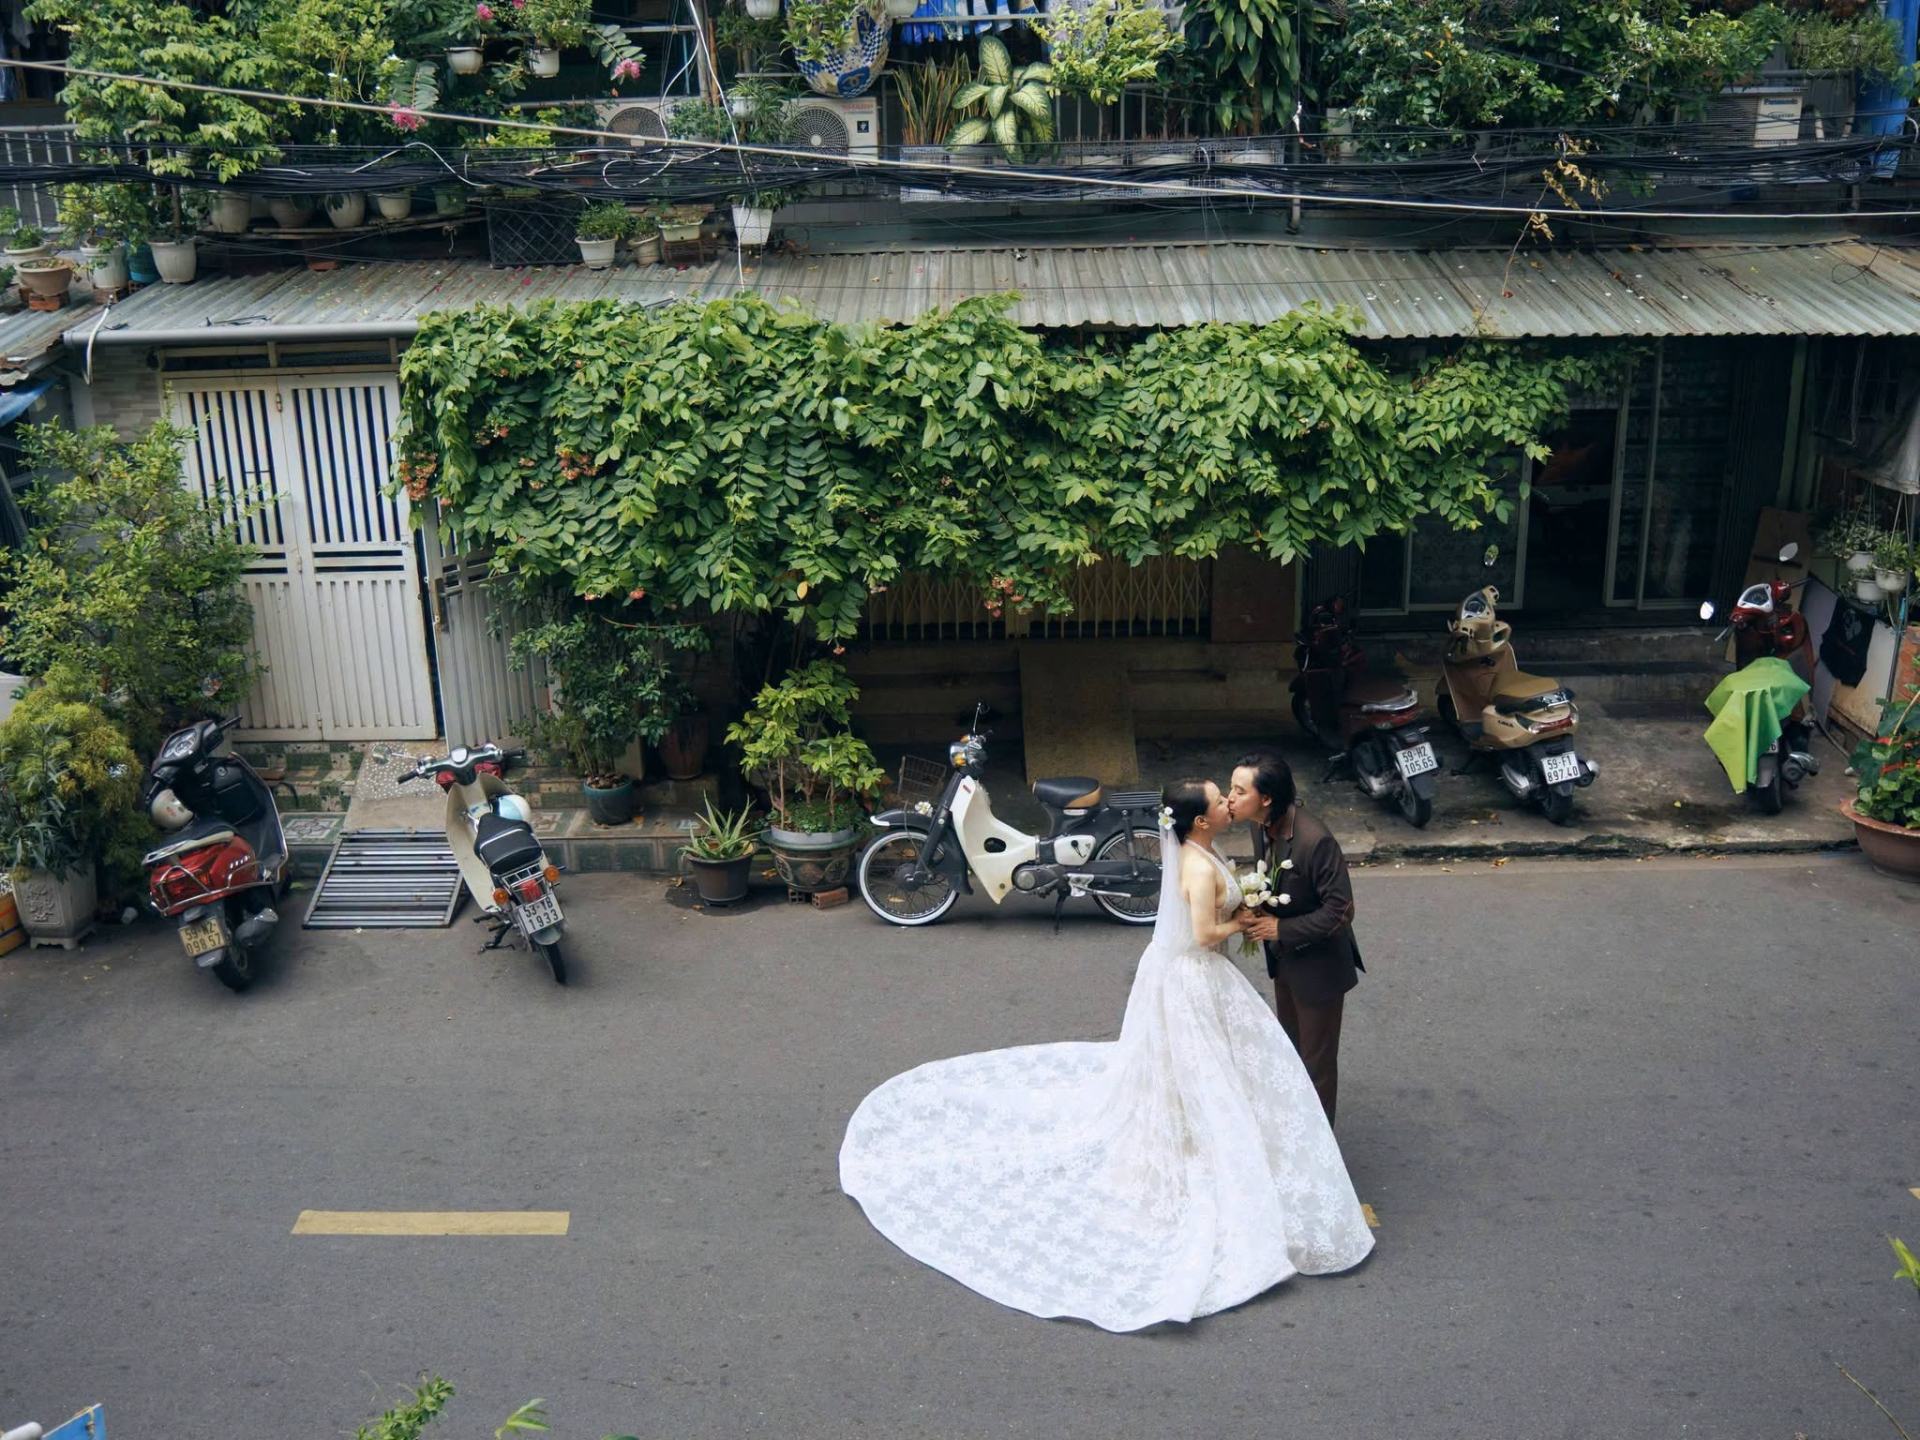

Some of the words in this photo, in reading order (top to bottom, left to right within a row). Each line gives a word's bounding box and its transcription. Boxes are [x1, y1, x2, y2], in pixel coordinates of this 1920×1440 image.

[1402, 745, 1428, 763] 59-H2
[1547, 755, 1572, 770] 59-F1
[1405, 756, 1434, 775] 105.65
[528, 908, 559, 931] 1933
